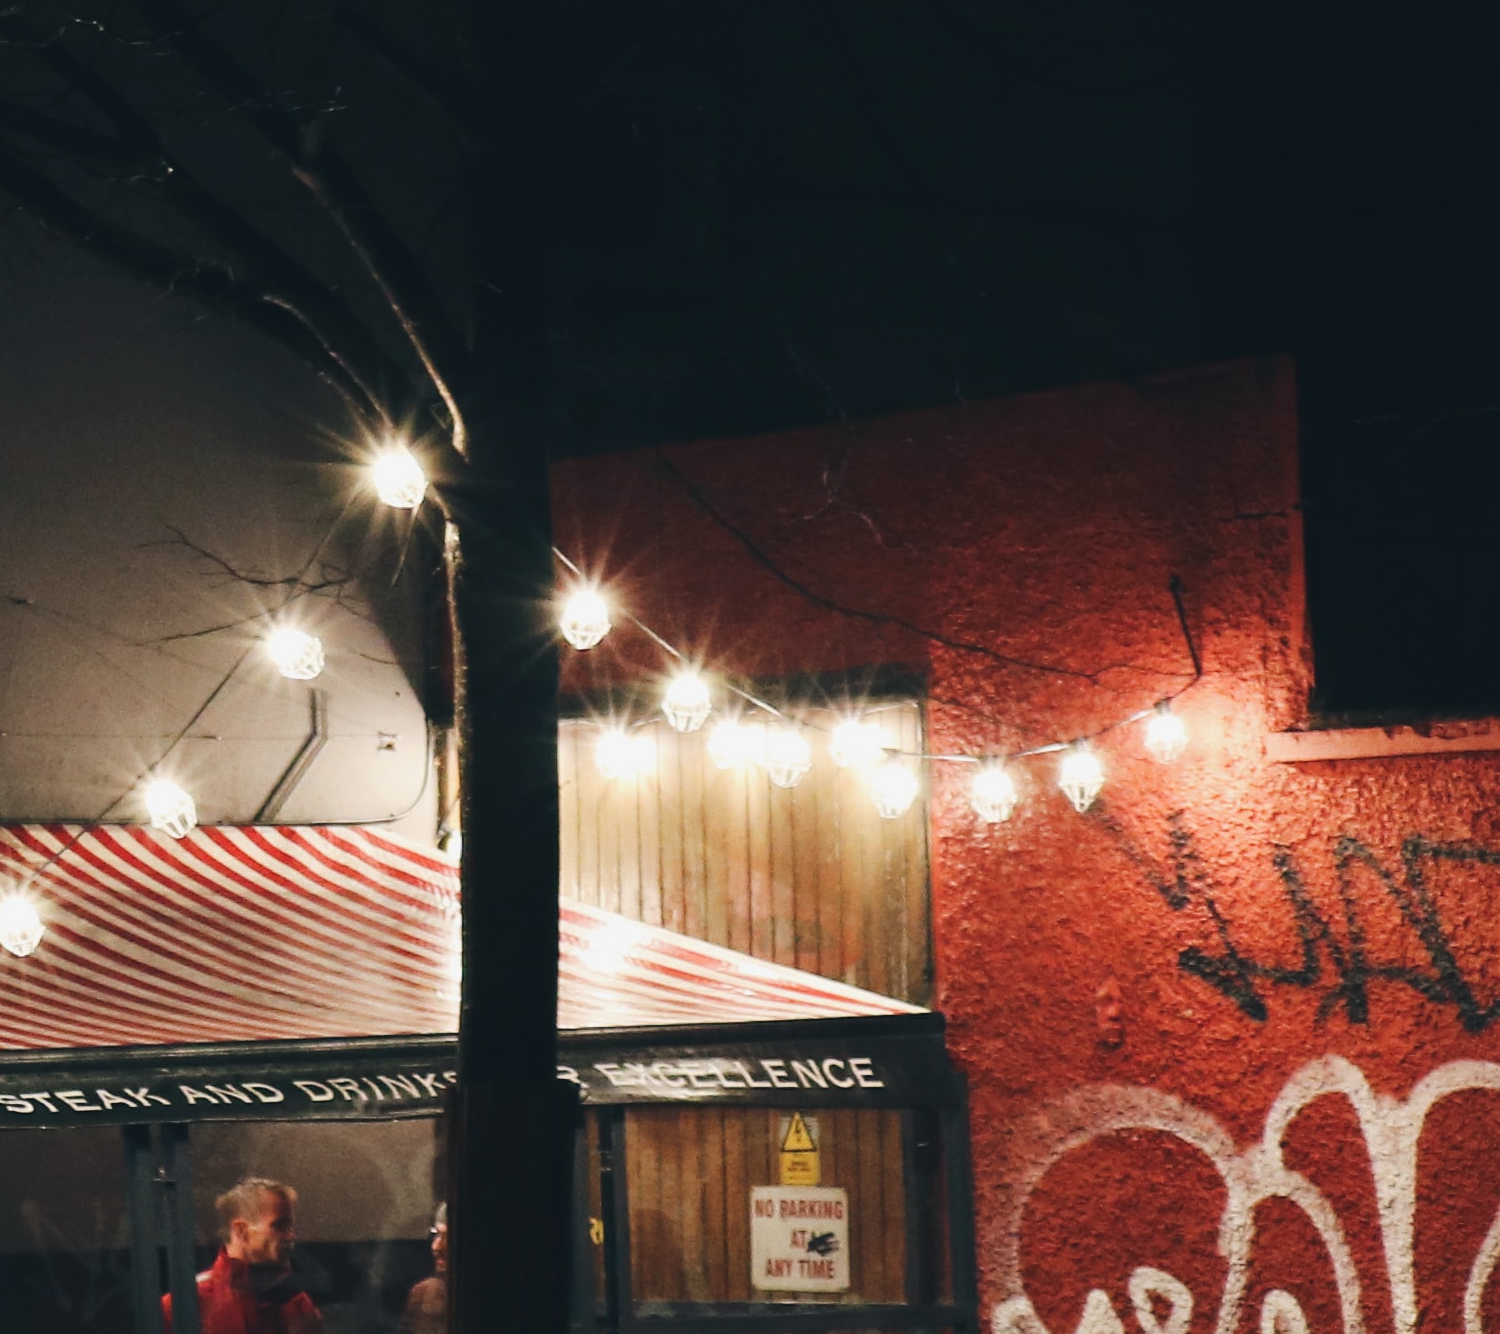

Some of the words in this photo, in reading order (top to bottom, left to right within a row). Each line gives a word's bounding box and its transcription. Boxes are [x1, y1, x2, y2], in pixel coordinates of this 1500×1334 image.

[594, 1057, 885, 1089] EXCELLENCE
[178, 1082, 286, 1106] AND
[755, 1199, 774, 1218] NO
[780, 1199, 843, 1219] PARKING
[790, 1230, 807, 1248] AT
[766, 1259, 792, 1278] ANY
[799, 1259, 834, 1278] TIME
